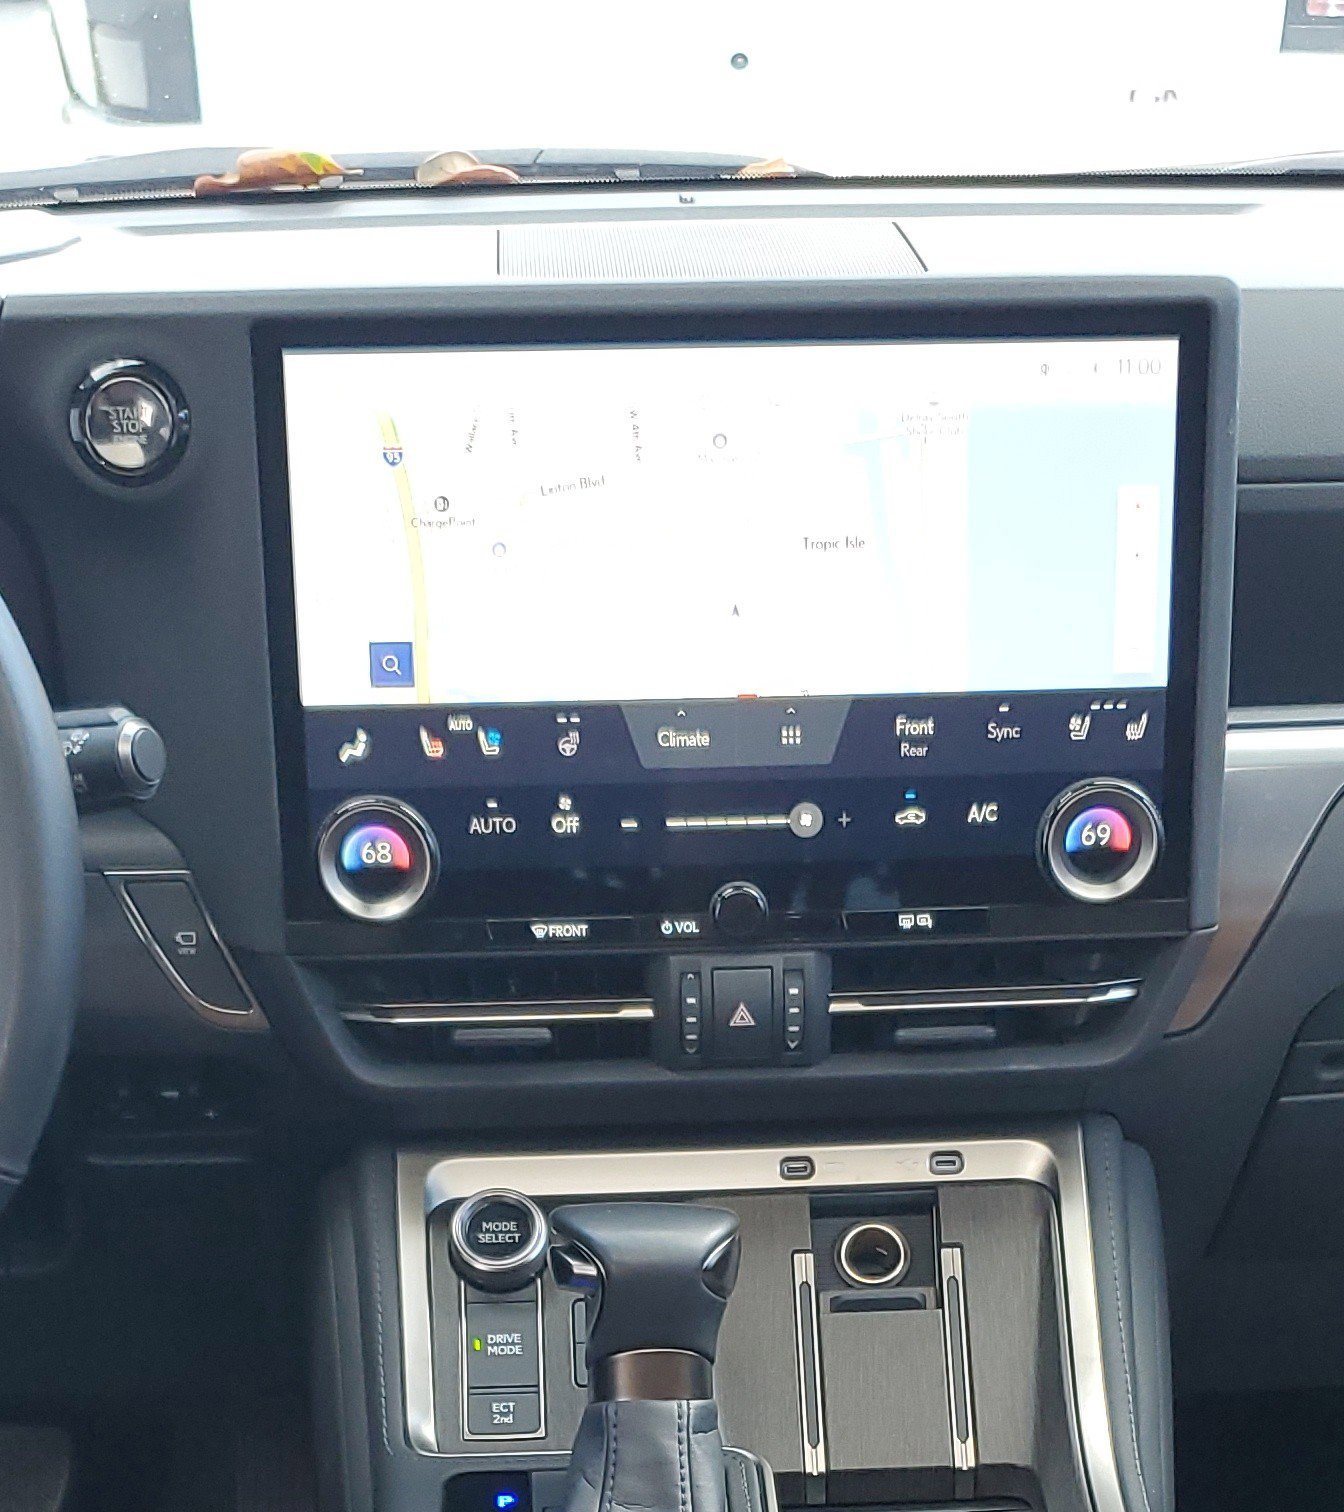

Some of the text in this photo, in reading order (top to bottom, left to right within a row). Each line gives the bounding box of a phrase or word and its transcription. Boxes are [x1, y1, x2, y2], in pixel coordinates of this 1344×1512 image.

[803, 536, 866, 551] Tropic Isle
[448, 714, 474, 731] AUTO
[895, 716, 935, 736] Front
[657, 727, 711, 749] Climate
[987, 722, 1021, 743] Sync
[900, 743, 928, 757] Rear
[967, 803, 999, 823] A/C
[469, 817, 516, 834] AUTO
[1080, 824, 1111, 846] 69
[361, 841, 393, 865] 68
[548, 924, 588, 939] FRONT
[674, 920, 700, 934] VOL
[482, 1221, 518, 1232] MODE
[478, 1233, 522, 1244] SELECT
[487, 1333, 522, 1344] DRIVE
[487, 1345, 523, 1356] MODE
[492, 1402, 515, 1412] ECT
[492, 1413, 514, 1424] 2nd
[497, 1494, 515, 1508] P
